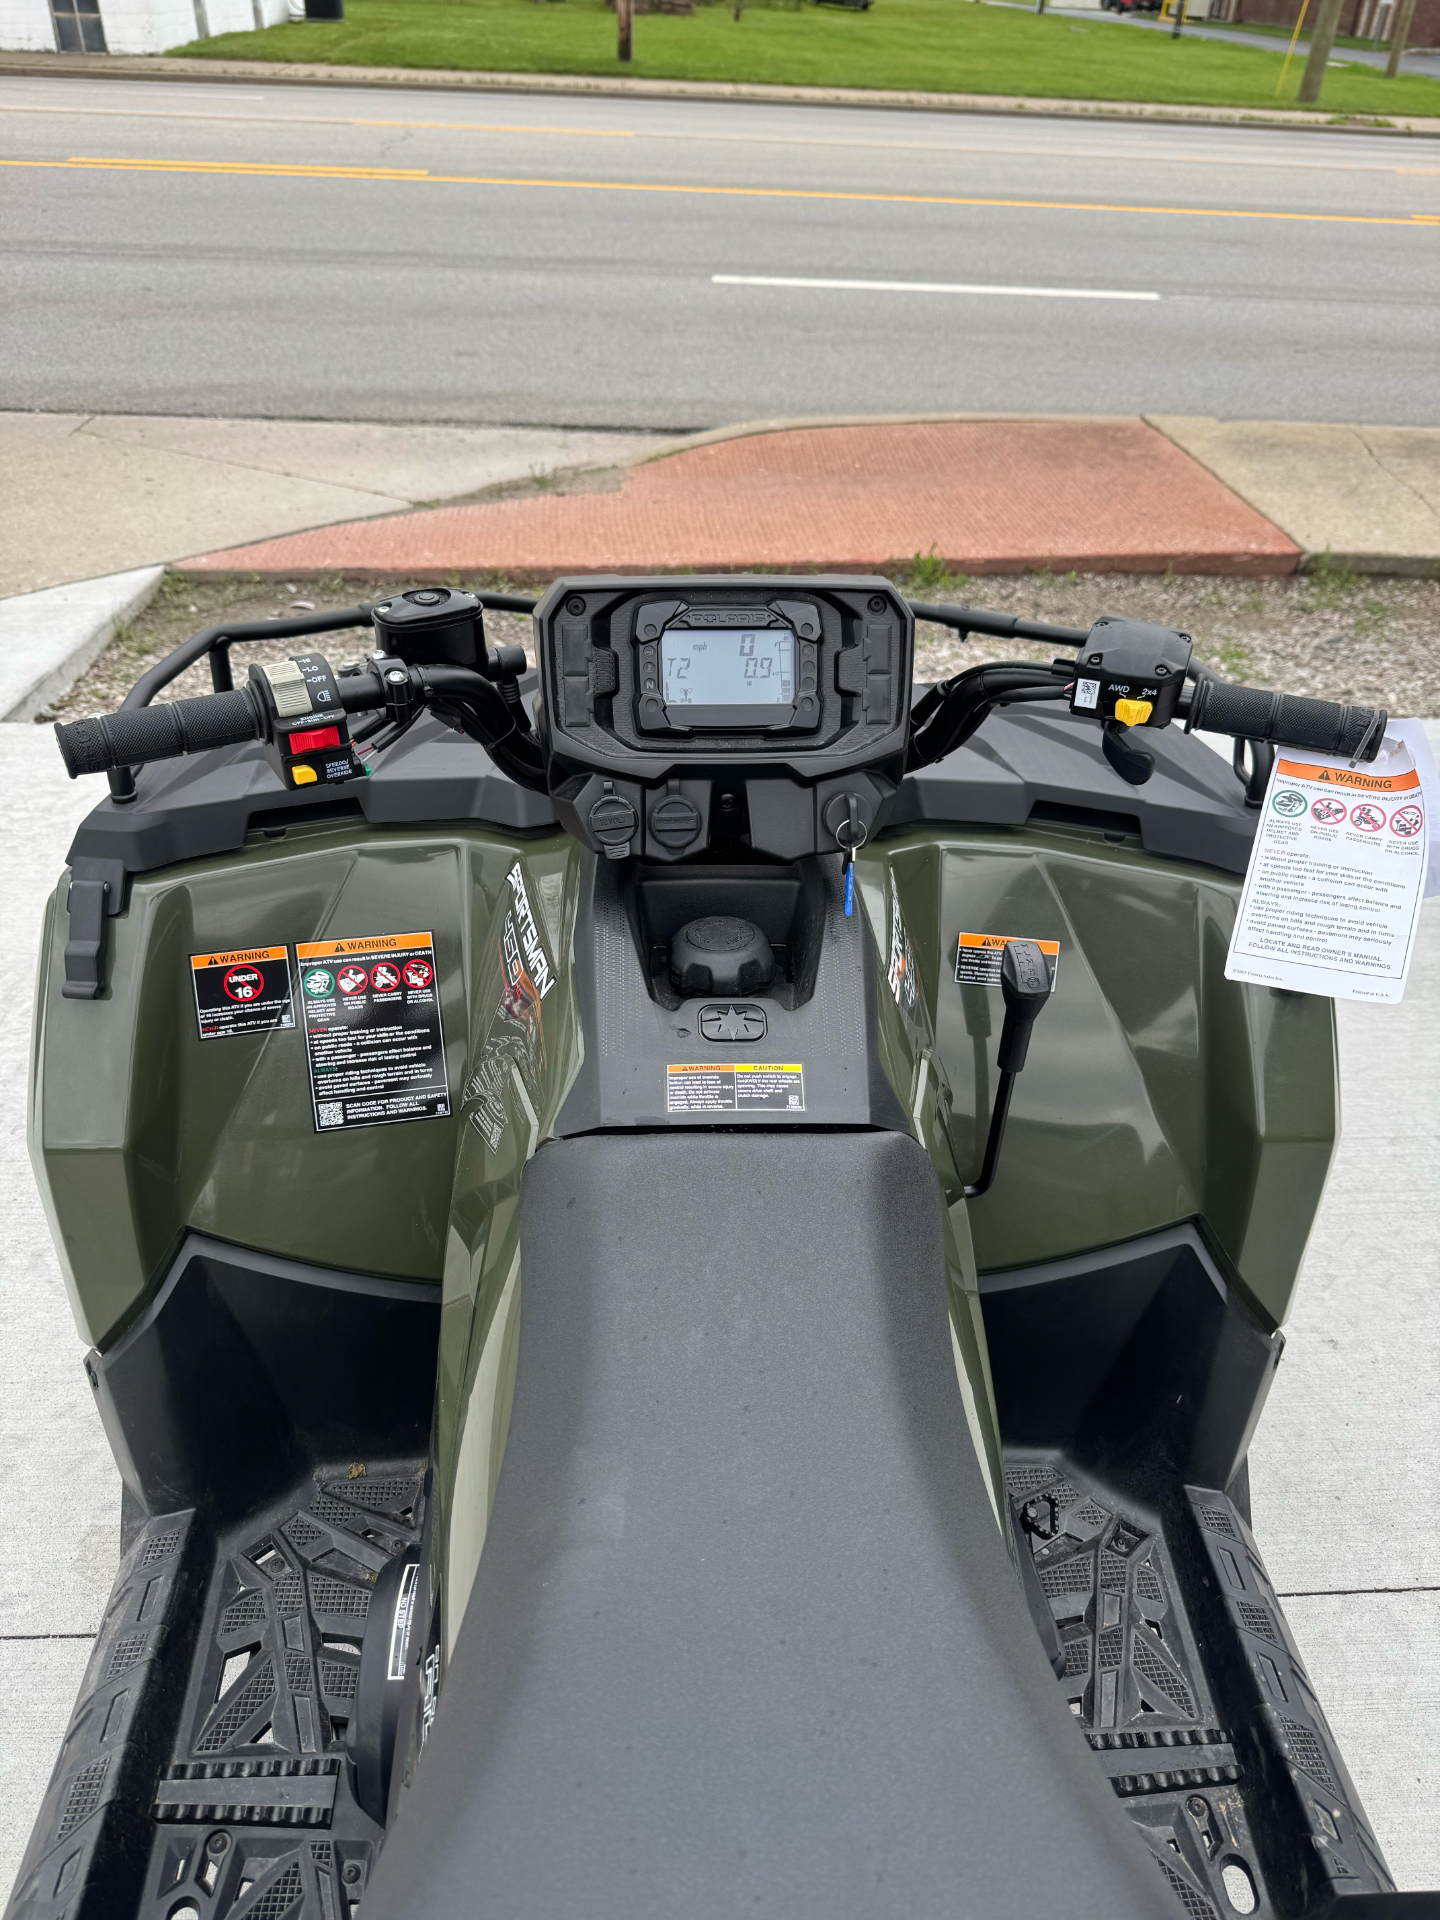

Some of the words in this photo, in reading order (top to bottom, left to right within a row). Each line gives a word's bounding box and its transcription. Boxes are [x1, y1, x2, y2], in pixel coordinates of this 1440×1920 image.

[692, 614, 766, 623] POLARIS
[692, 642, 707, 652] mph
[739, 633, 756, 656] 0
[743, 657, 773, 679] 0.9
[312, 675, 327, 683] OFF
[646, 681, 654, 689] N
[1108, 684, 1130, 693] AWD
[327, 769, 352, 779] OVERRIDE
[1334, 772, 1392, 789] WARNING
[1252, 898, 1282, 908] ALWAYS:
[506, 861, 556, 1000] SPORTSMAN
[347, 939, 397, 950] WARNING
[1260, 937, 1286, 947] LOCATE
[1302, 944, 1321, 952] READ
[220, 951, 270, 963] WARNING
[1249, 942, 1276, 951] FOLLOW
[1290, 948, 1338, 962] INSTRUCTIONS
[229, 973, 258, 983] UNDER
[235, 986, 253, 999] 16
[347, 1111, 385, 1120] INSTRUCTIONS
[401, 1597, 408, 1608] NO
[397, 1608, 406, 1629] STEP
